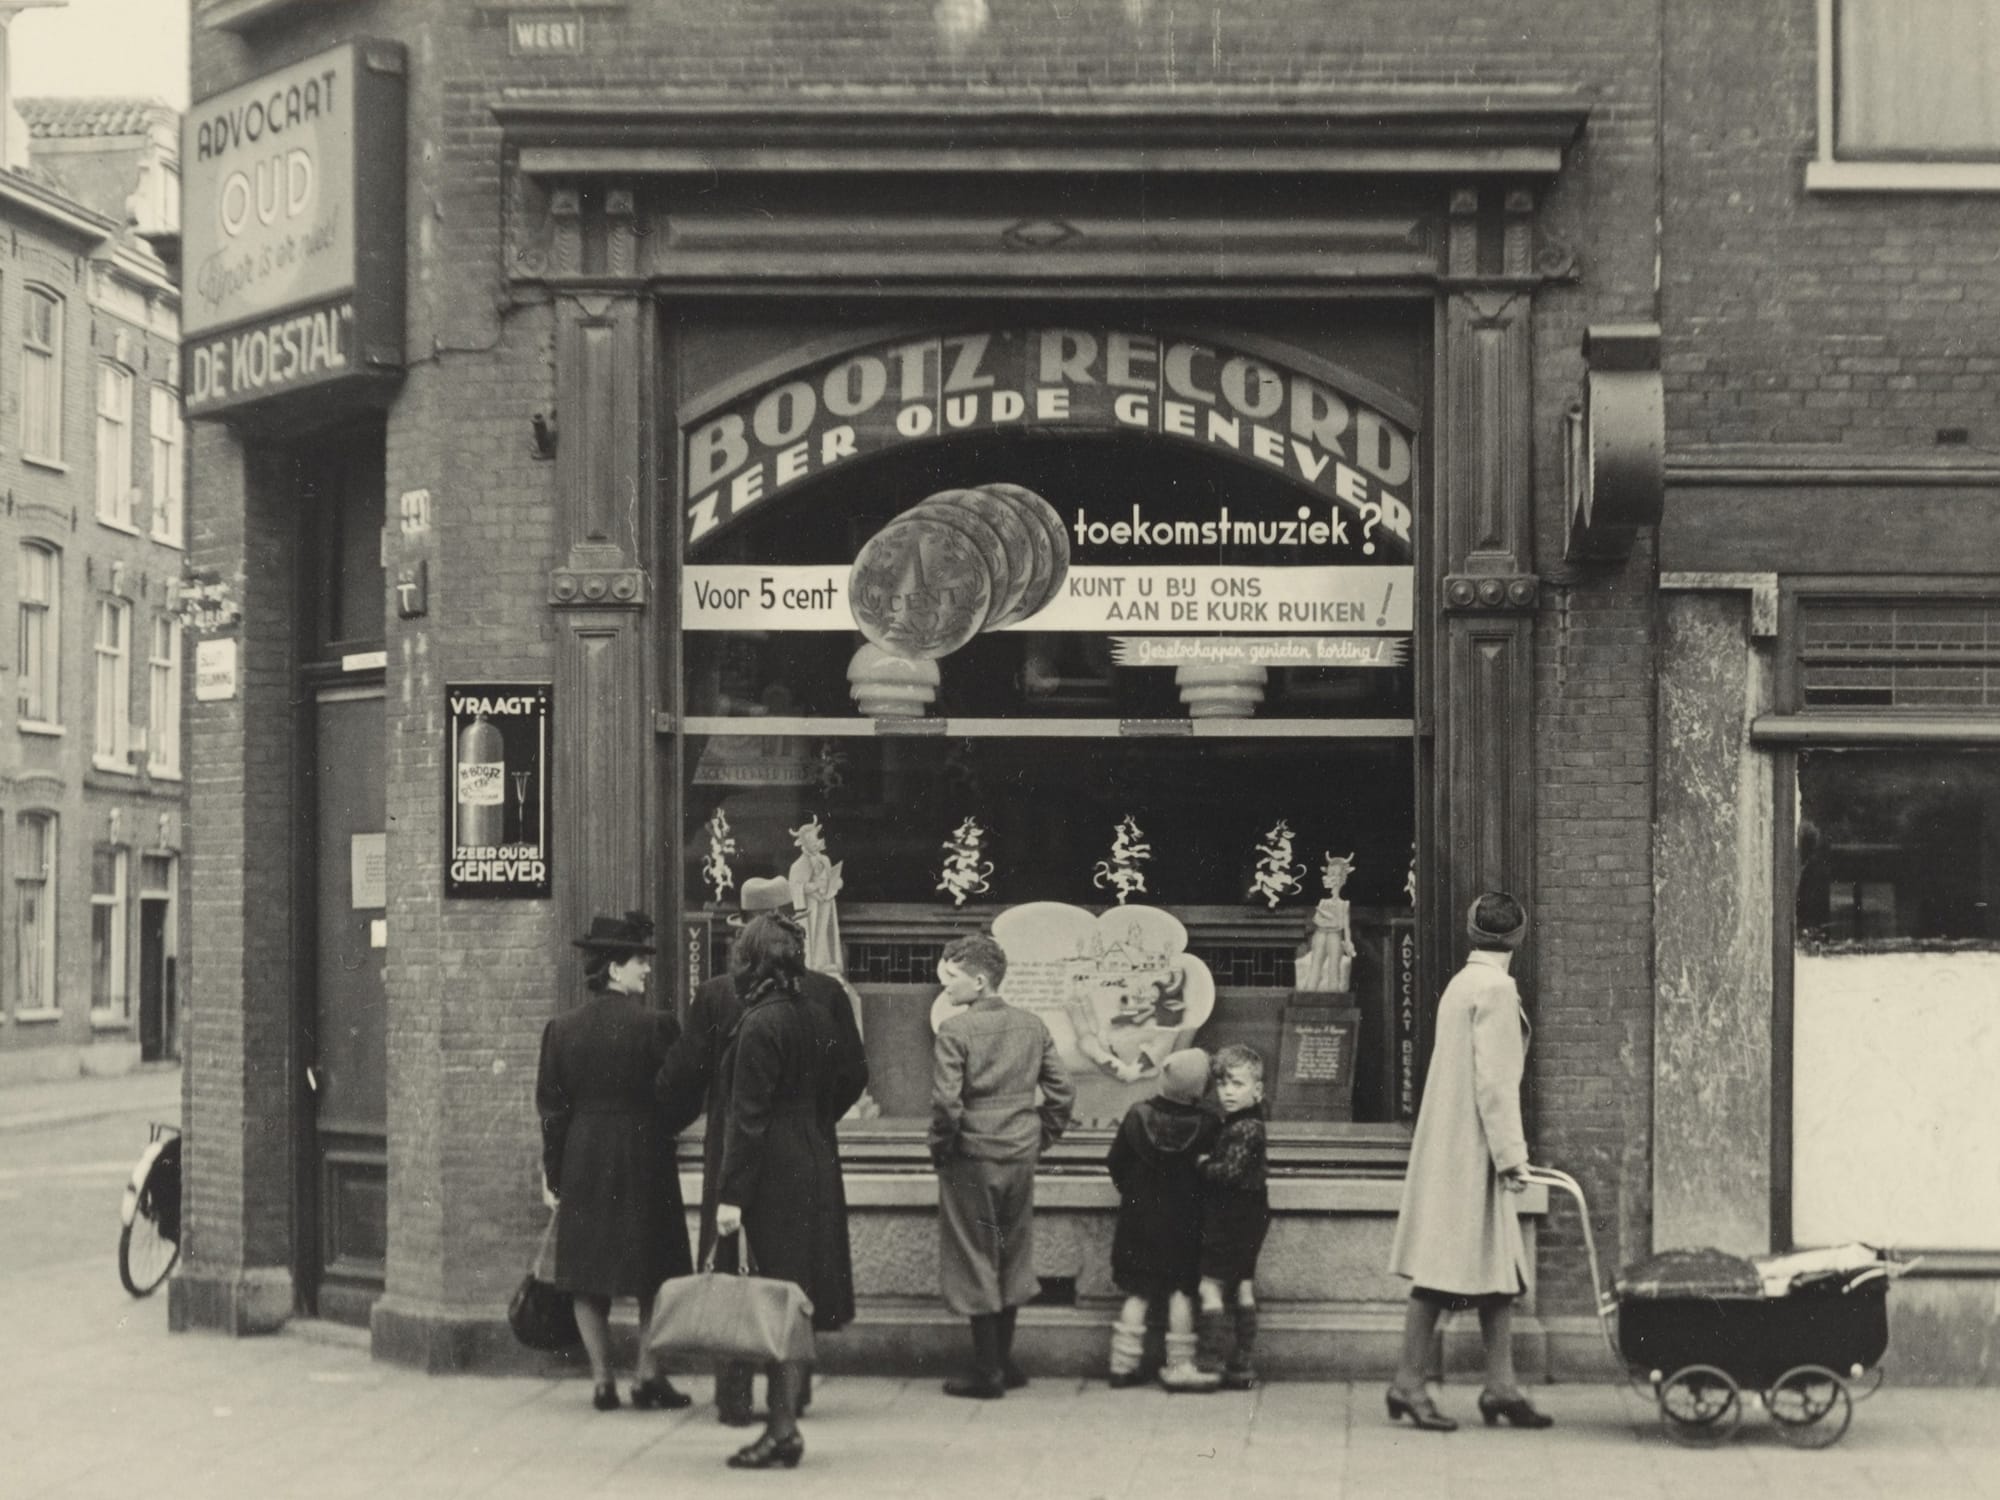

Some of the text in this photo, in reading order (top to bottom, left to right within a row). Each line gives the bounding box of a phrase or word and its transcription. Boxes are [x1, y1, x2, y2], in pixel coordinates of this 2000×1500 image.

[198, 70, 336, 162] ADVOCAAT
[221, 147, 313, 238] OUD
[688, 329, 1411, 498] BOOTZ RECORD
[688, 388, 1412, 543] ZEER OUDE GENEVER
[1073, 503, 1350, 546] toekomstmuziek
[694, 577, 838, 610] Voor 5 cent
[1069, 577, 1126, 598] KUNT
[1138, 577, 1152, 597] U
[1211, 577, 1262, 598] ONS
[1106, 602, 1160, 621] AAN
[1170, 602, 1198, 621] DE
[1207, 602, 1268, 622] KURK
[1278, 602, 1366, 622] RUIKEN
[450, 861, 546, 882] GENEVER
[456, 847, 538, 860] ZEER OUDE
[1402, 933, 1414, 1114] ADVOCAAT BESSEN
